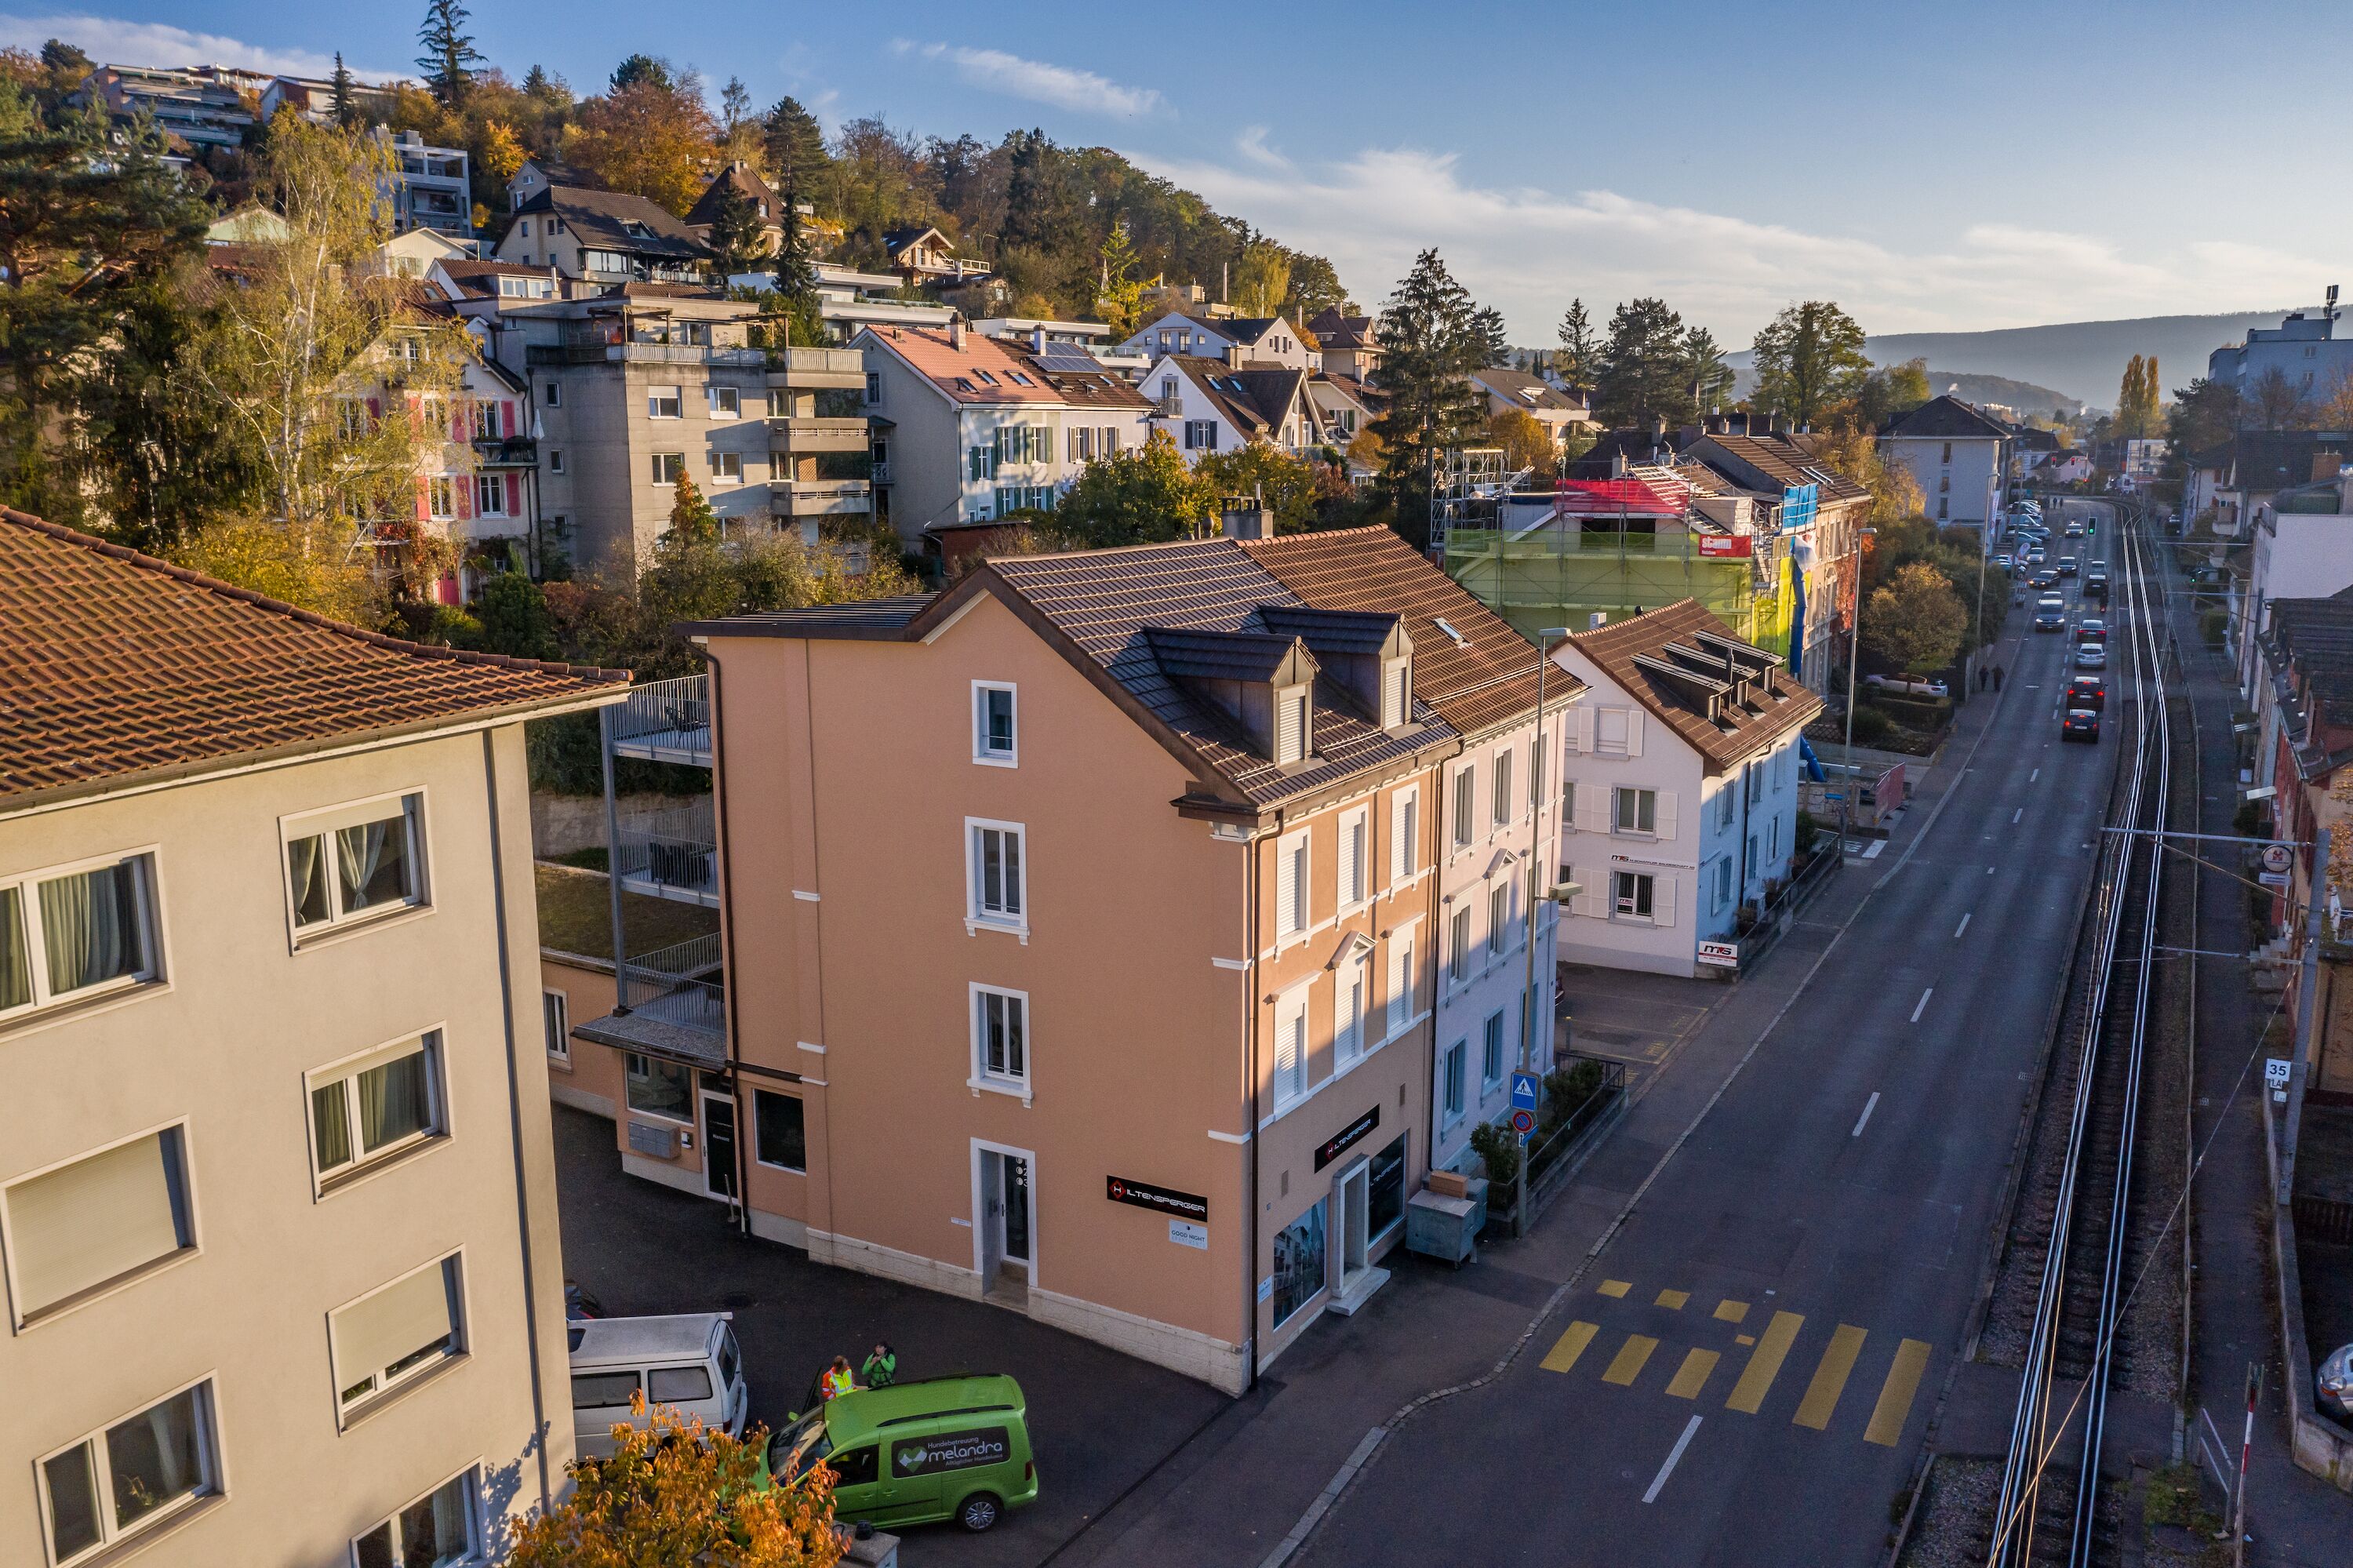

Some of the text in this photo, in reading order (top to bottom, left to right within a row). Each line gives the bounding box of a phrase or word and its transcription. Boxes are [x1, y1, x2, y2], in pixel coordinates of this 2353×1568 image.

[2269, 1064, 2286, 1075] 35
[1171, 1230, 1187, 1239] GOOD
[1188, 1234, 1206, 1242] NIGHT
[928, 1437, 979, 1449] Hundebetreuung
[929, 1441, 1002, 1463] melandra
